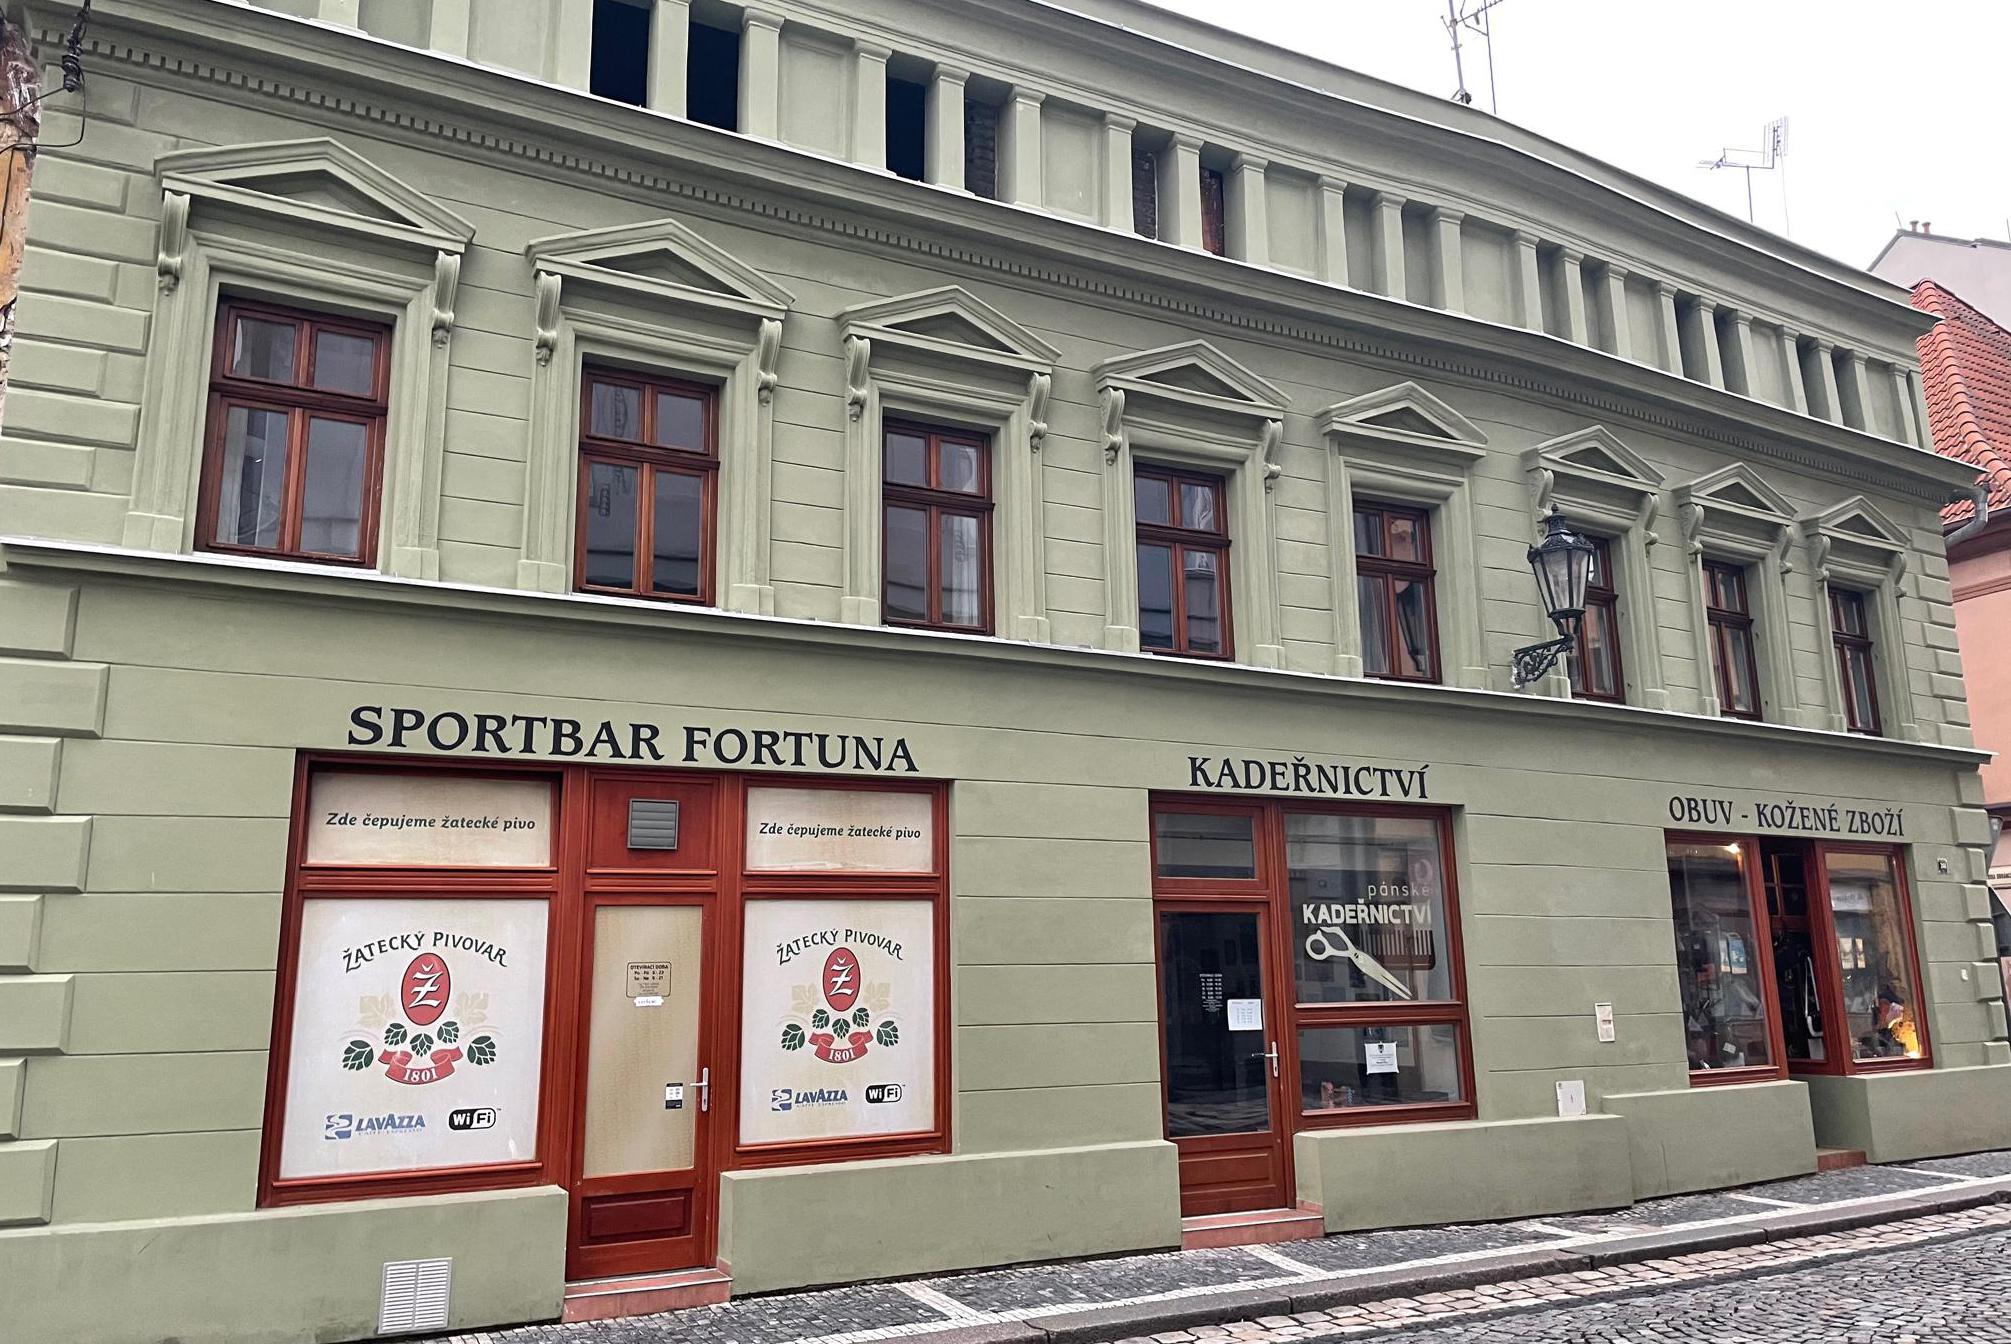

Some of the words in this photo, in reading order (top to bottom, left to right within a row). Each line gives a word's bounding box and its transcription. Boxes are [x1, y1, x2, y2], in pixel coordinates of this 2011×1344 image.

[348, 706, 665, 762] SPORTBAR
[682, 726, 920, 772] FORTUNA
[1188, 756, 1430, 799] KADEŘNICTVÍ
[325, 812, 357, 826] Zde
[362, 813, 436, 830] čepujeme
[441, 815, 499, 829] žatecké
[503, 817, 536, 831] pivo
[1669, 796, 1733, 825] OBUV
[1755, 800, 1841, 832] KOŽENÉ
[1846, 808, 1904, 837] ZBOŽÍ
[759, 822, 783, 835] Zde
[787, 823, 844, 838] čepujeme
[848, 825, 892, 838] žatecké
[895, 827, 921, 840] pivo
[1367, 881, 1430, 900] pánské
[1302, 898, 1432, 924] KADEŘNICTVÍ
[342, 931, 425, 973] ŽATECKÝ
[433, 931, 508, 967] PIVOVAR
[776, 928, 839, 966] ŽATECKÝ
[845, 929, 903, 960] PIVOVAR
[829, 1048, 855, 1061] 1801
[404, 1068, 438, 1083] 1801
[794, 1088, 848, 1104] LAVAZZA
[355, 1113, 426, 1132] LAVAZZA
